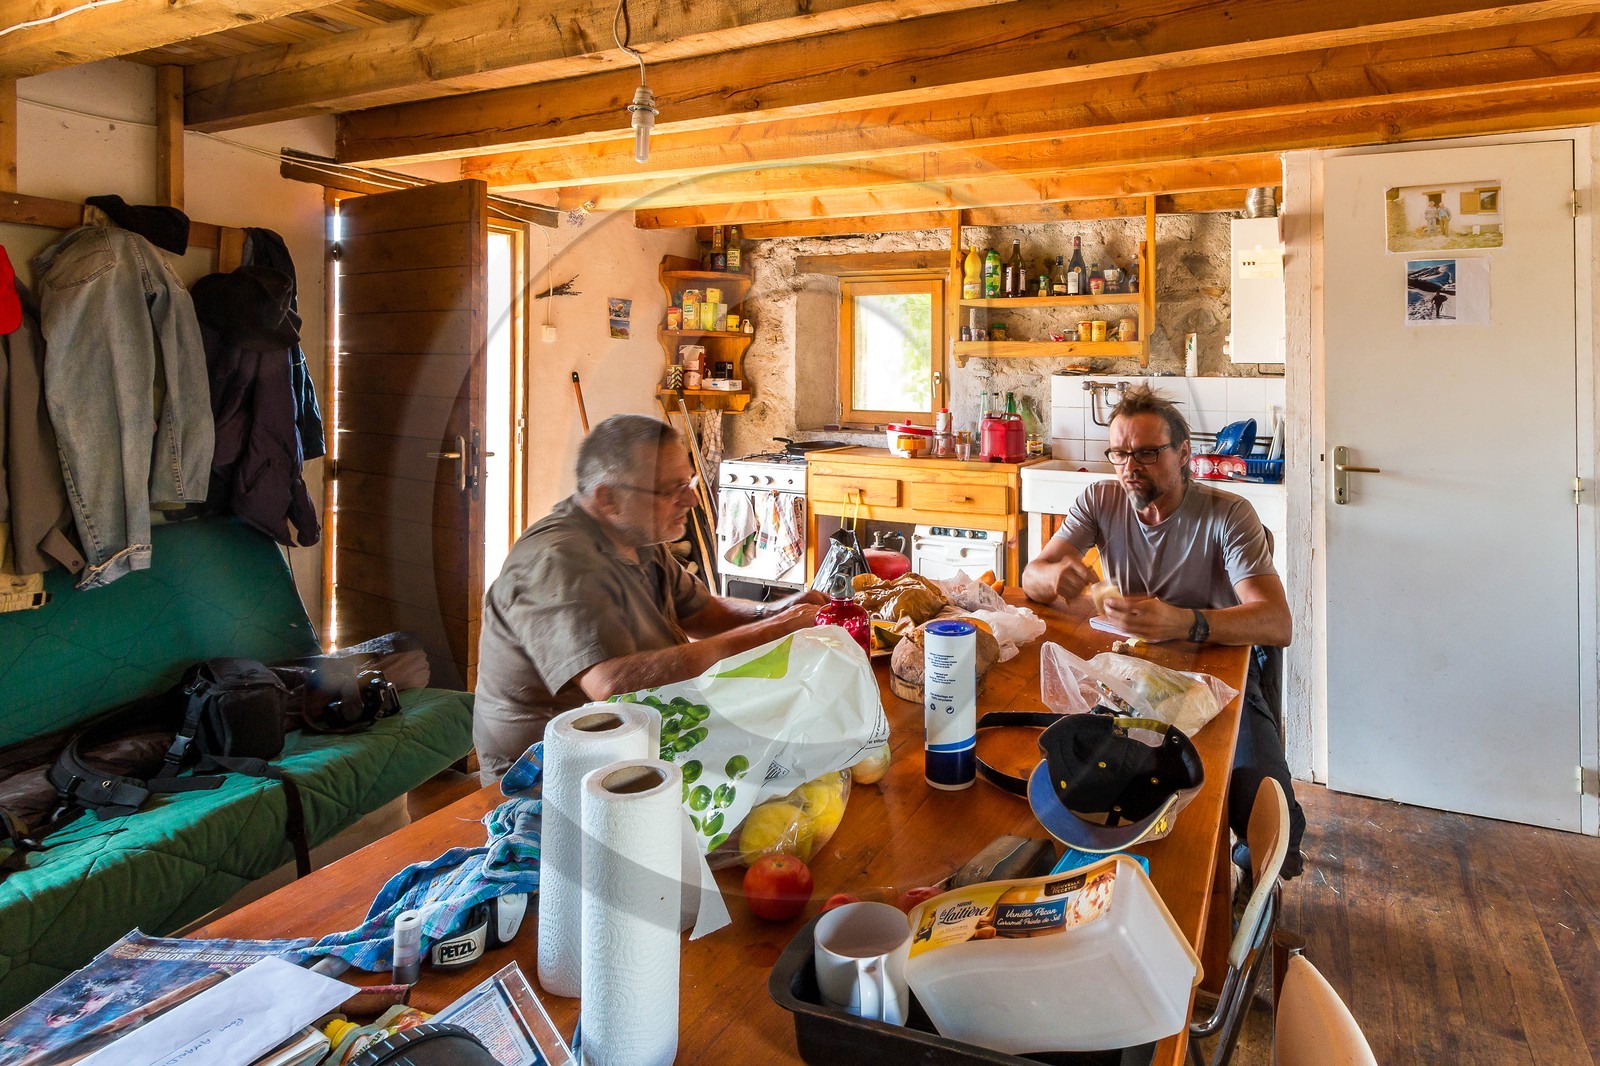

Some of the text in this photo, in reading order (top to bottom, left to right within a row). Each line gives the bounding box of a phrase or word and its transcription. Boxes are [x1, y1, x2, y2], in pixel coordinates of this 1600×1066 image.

[1052, 885, 1078, 894] RECETTE
[938, 906, 988, 925] Laitière
[1005, 908, 1033, 918] Vanille
[997, 917, 1023, 926] Caramel
[1050, 914, 1067, 922] Sel
[440, 941, 477, 964] PETZL
